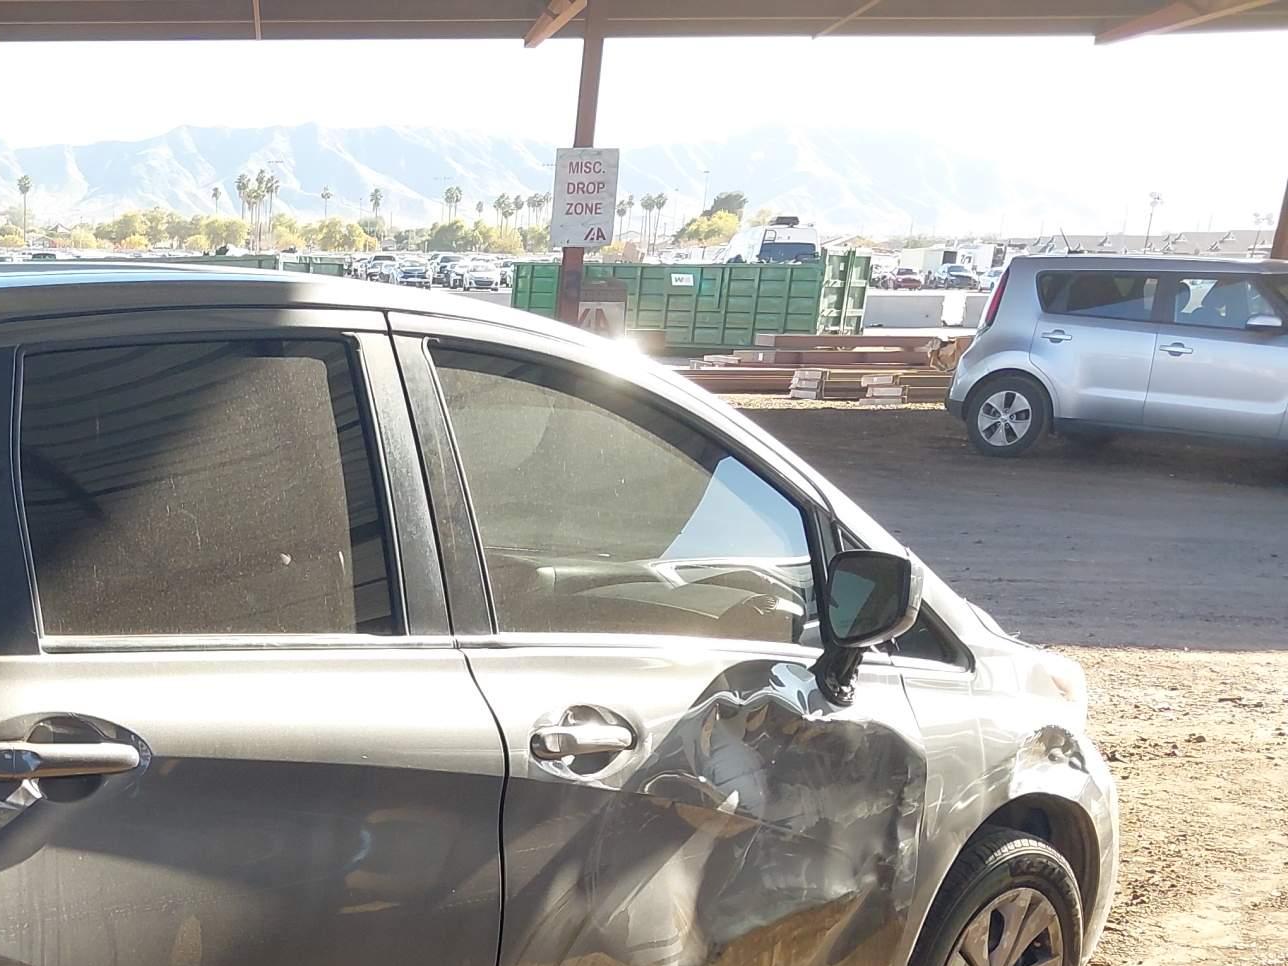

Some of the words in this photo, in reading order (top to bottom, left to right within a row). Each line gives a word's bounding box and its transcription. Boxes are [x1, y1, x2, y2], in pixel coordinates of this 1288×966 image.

[568, 161, 606, 175] MISC.
[566, 181, 606, 195] DROP
[565, 202, 603, 216] ZONE
